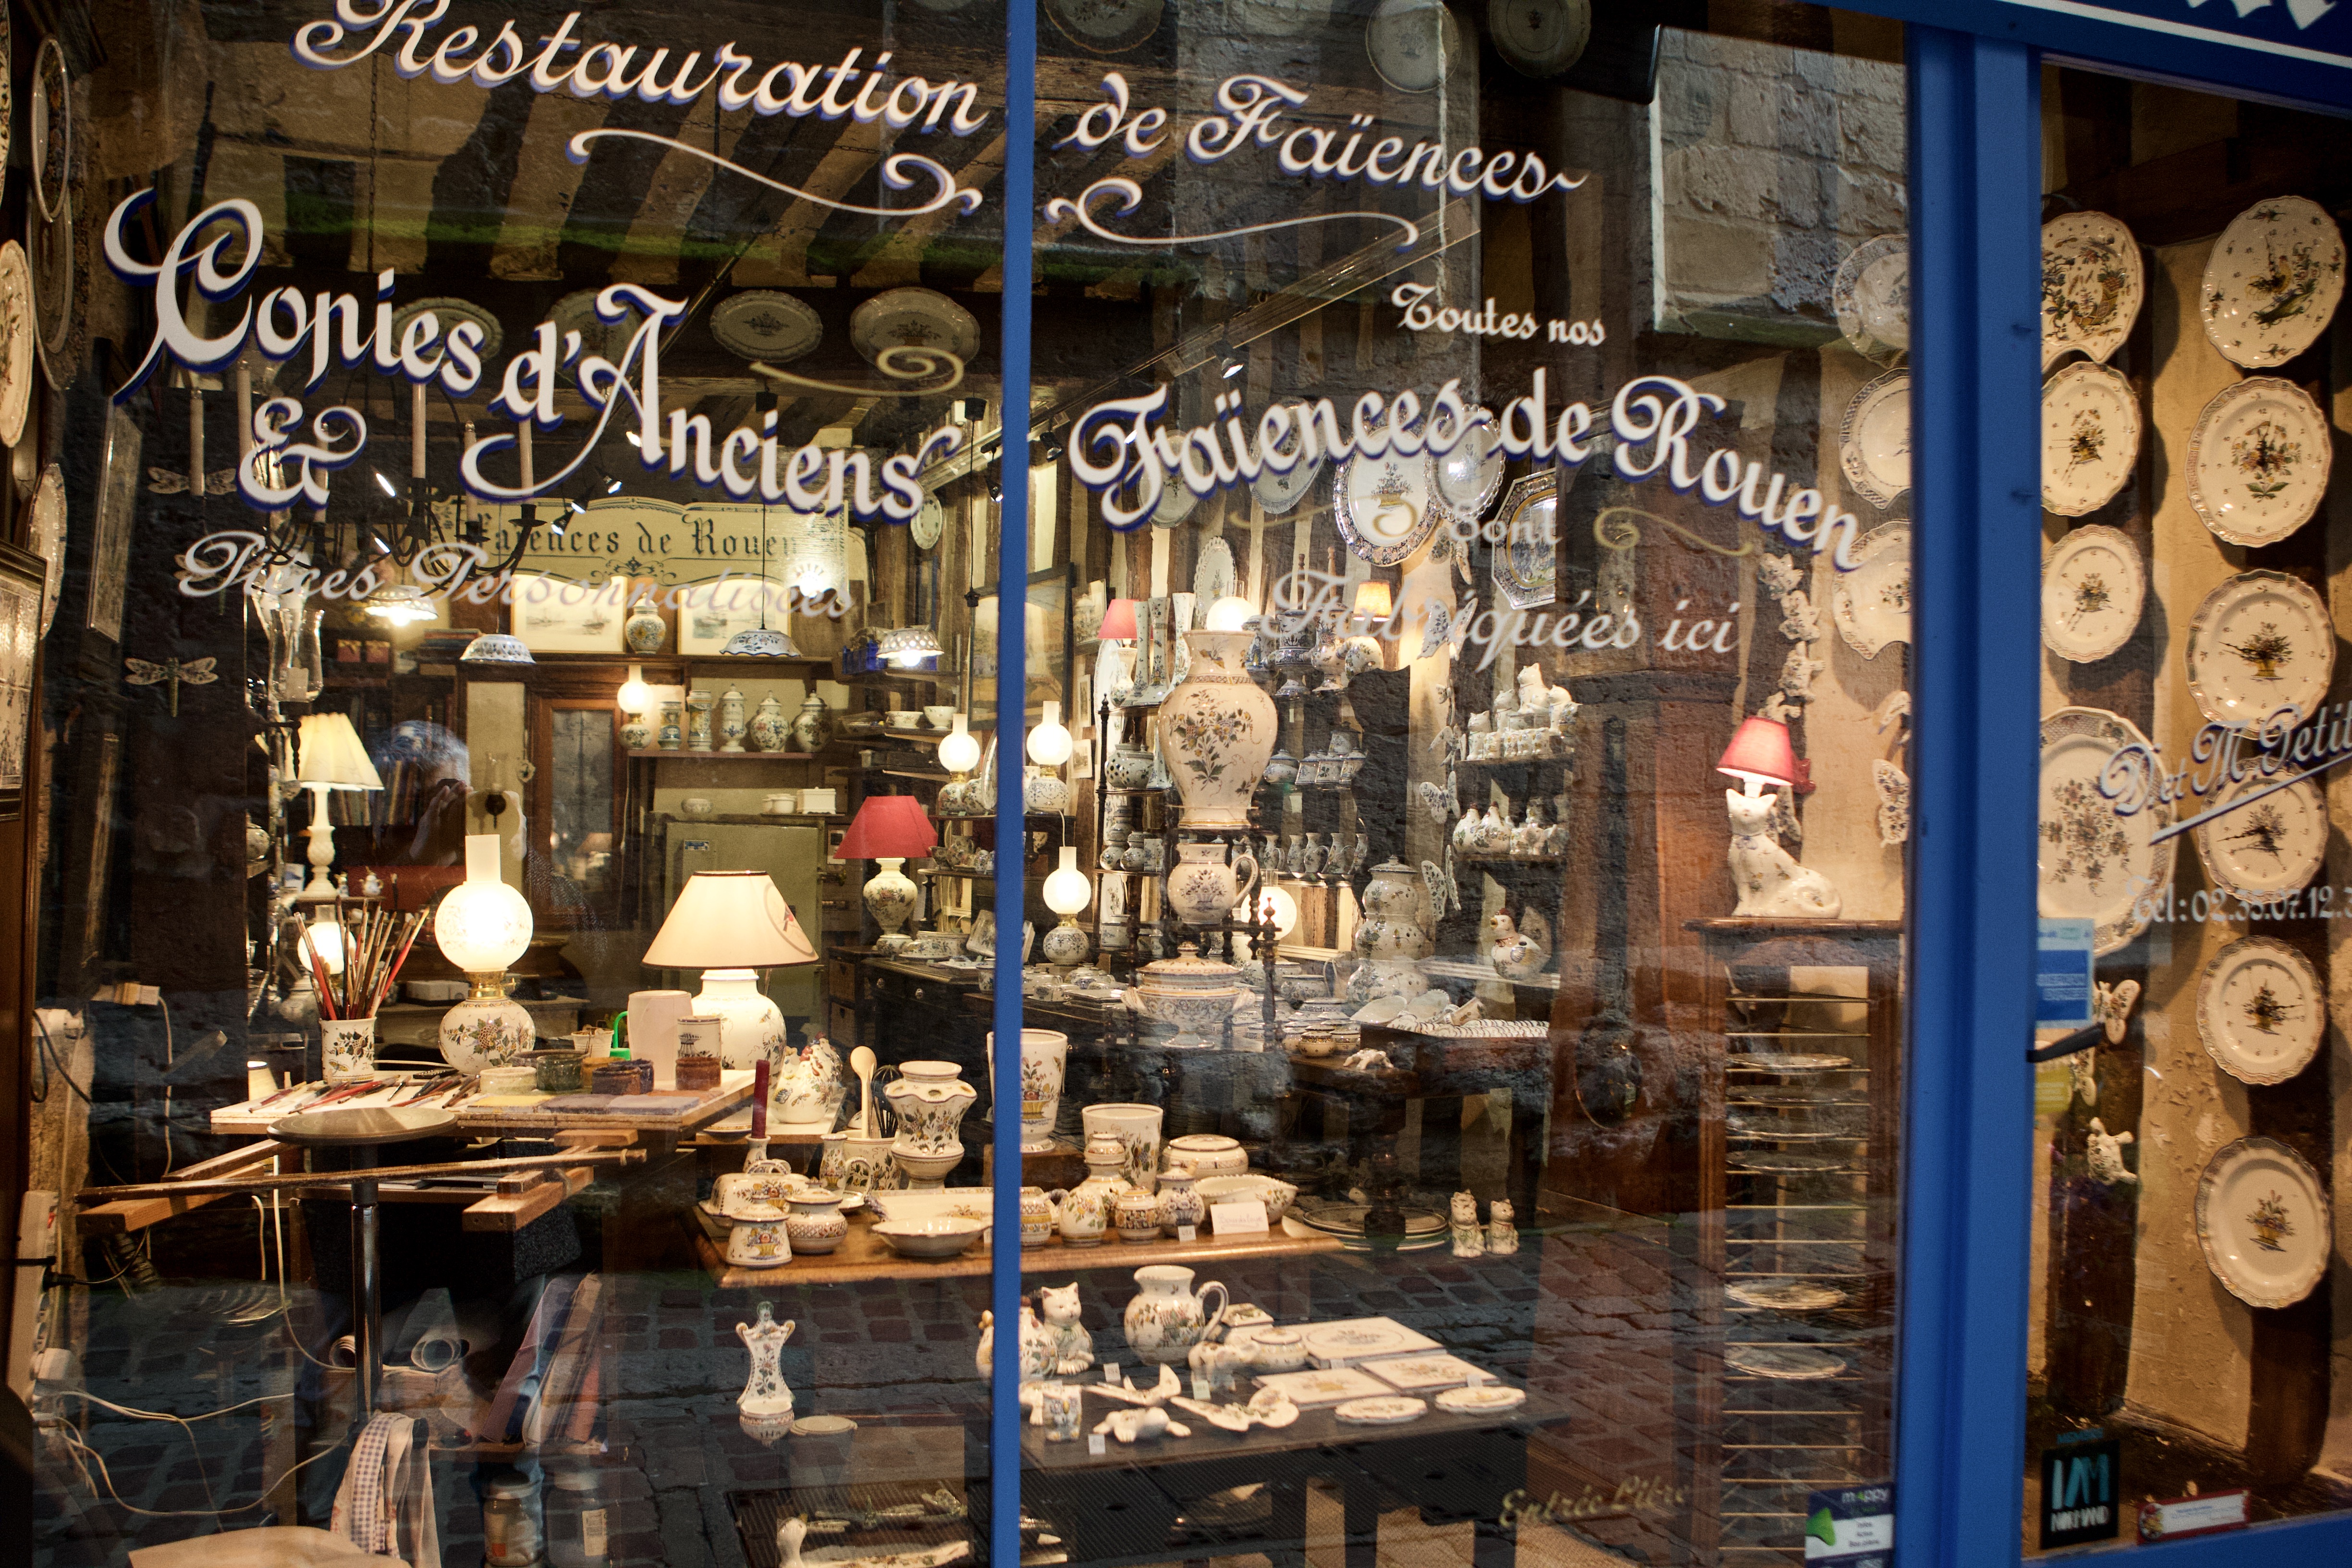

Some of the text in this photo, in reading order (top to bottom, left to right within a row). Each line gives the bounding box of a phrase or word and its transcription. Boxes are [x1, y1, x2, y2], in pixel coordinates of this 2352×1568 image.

[290, 0, 1590, 204] Restauration de Faïences
[103, 186, 484, 406] Copies
[1389, 282, 1606, 348] Toutes nos
[238, 396, 369, 515] &
[1068, 366, 1863, 573] Faïences de Rouen
[635, 521, 672, 555] de
[680, 511, 798, 557] Rouen
[1261, 567, 1741, 673] Fabriquées ici
